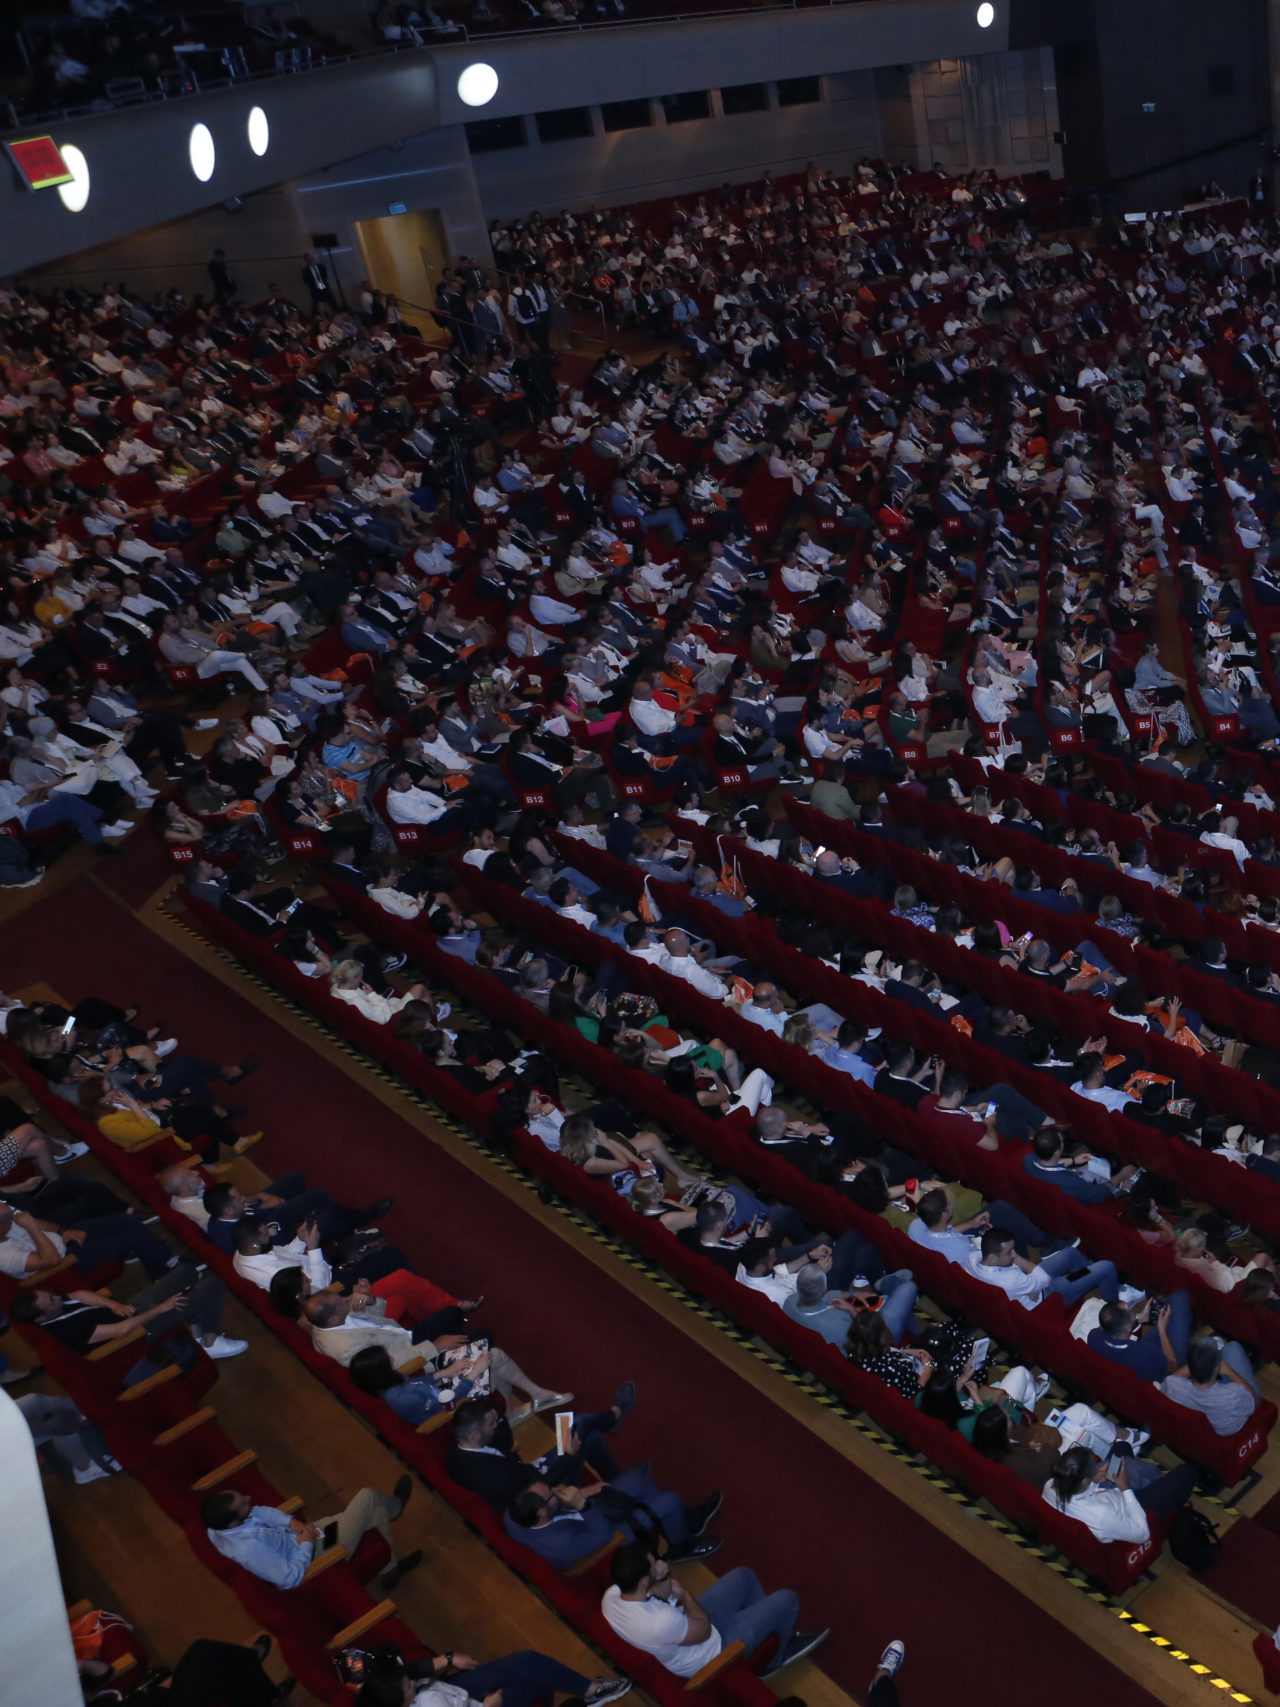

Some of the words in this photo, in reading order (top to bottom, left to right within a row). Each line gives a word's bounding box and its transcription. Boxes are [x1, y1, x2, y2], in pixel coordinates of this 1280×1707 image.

[176, 670, 187, 678] E1
[1139, 721, 1150, 730] B5
[1219, 723, 1231, 731] B4
[1061, 734, 1072, 742] B6
[723, 774, 741, 784] B10
[626, 785, 643, 794] B11
[526, 795, 544, 804] B12
[399, 832, 418, 840] B13
[293, 841, 312, 849] B14
[174, 850, 193, 860] B15
[1238, 1432, 1259, 1458] C14
[1128, 1540, 1152, 1565] C15
